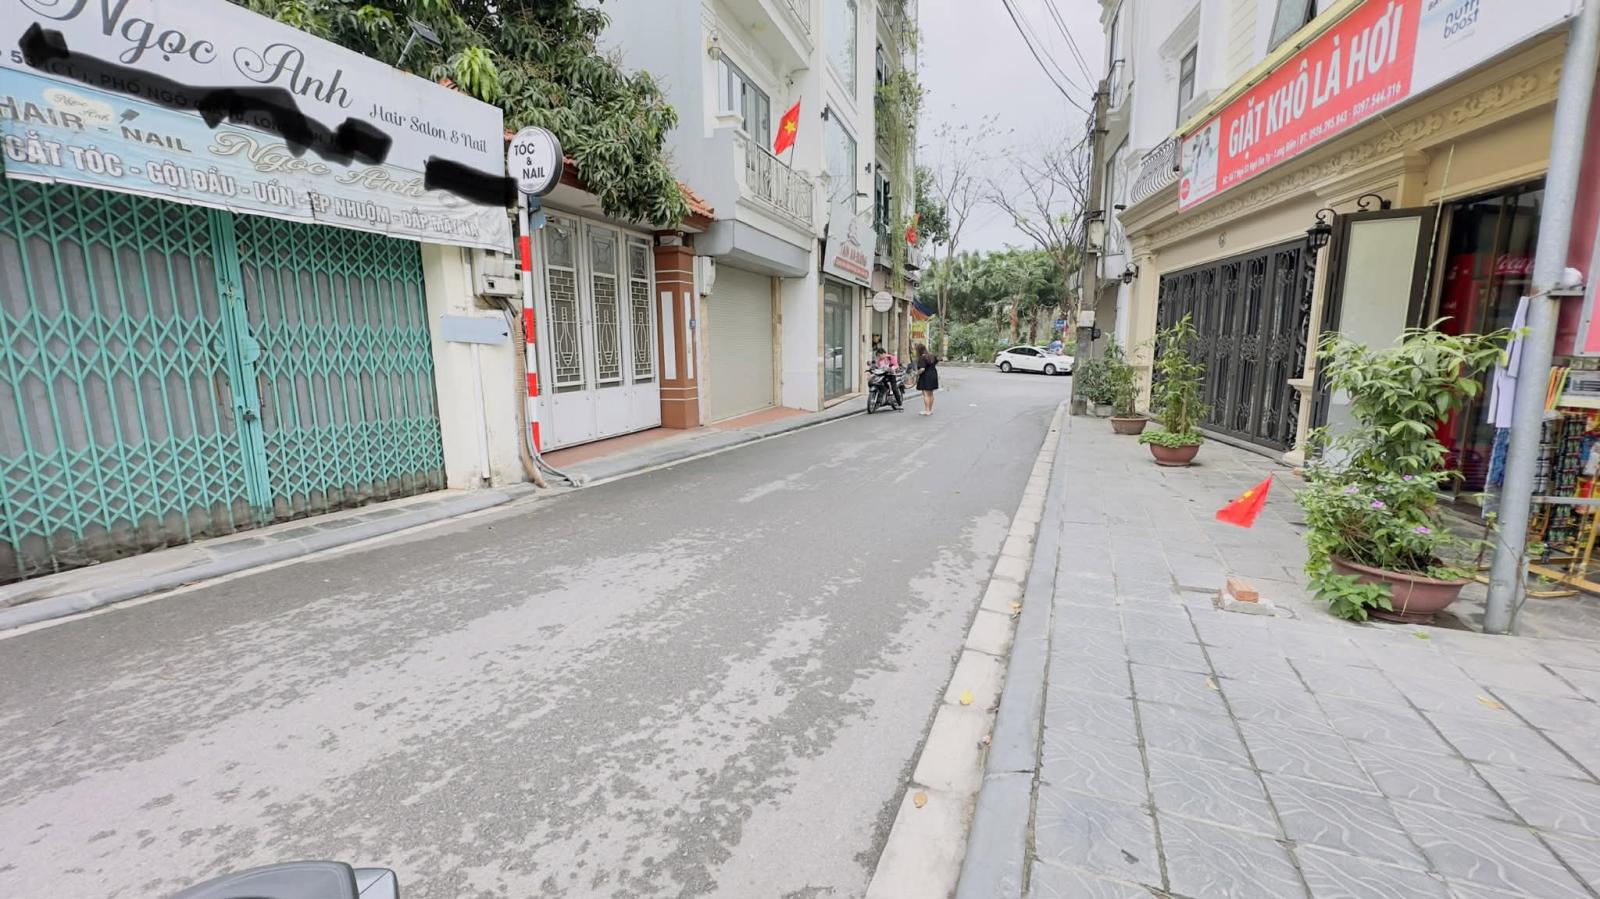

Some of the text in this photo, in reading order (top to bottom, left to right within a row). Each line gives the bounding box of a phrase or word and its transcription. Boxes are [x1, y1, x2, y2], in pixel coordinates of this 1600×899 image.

[1443, 8, 1479, 39] boost
[233, 43, 353, 109] Anh
[1229, 1, 1403, 159] GIẶT KHÔ LÀ HƠI
[0, 95, 85, 130] HAIR
[120, 126, 192, 153] NAIL
[369, 104, 488, 153] Hair Salon & Nail
[514, 141, 535, 157] TÓC
[526, 157, 532, 166] &
[146, 159, 188, 191] GỘI
[335, 167, 426, 197] Anh
[522, 166, 546, 180] NAIL
